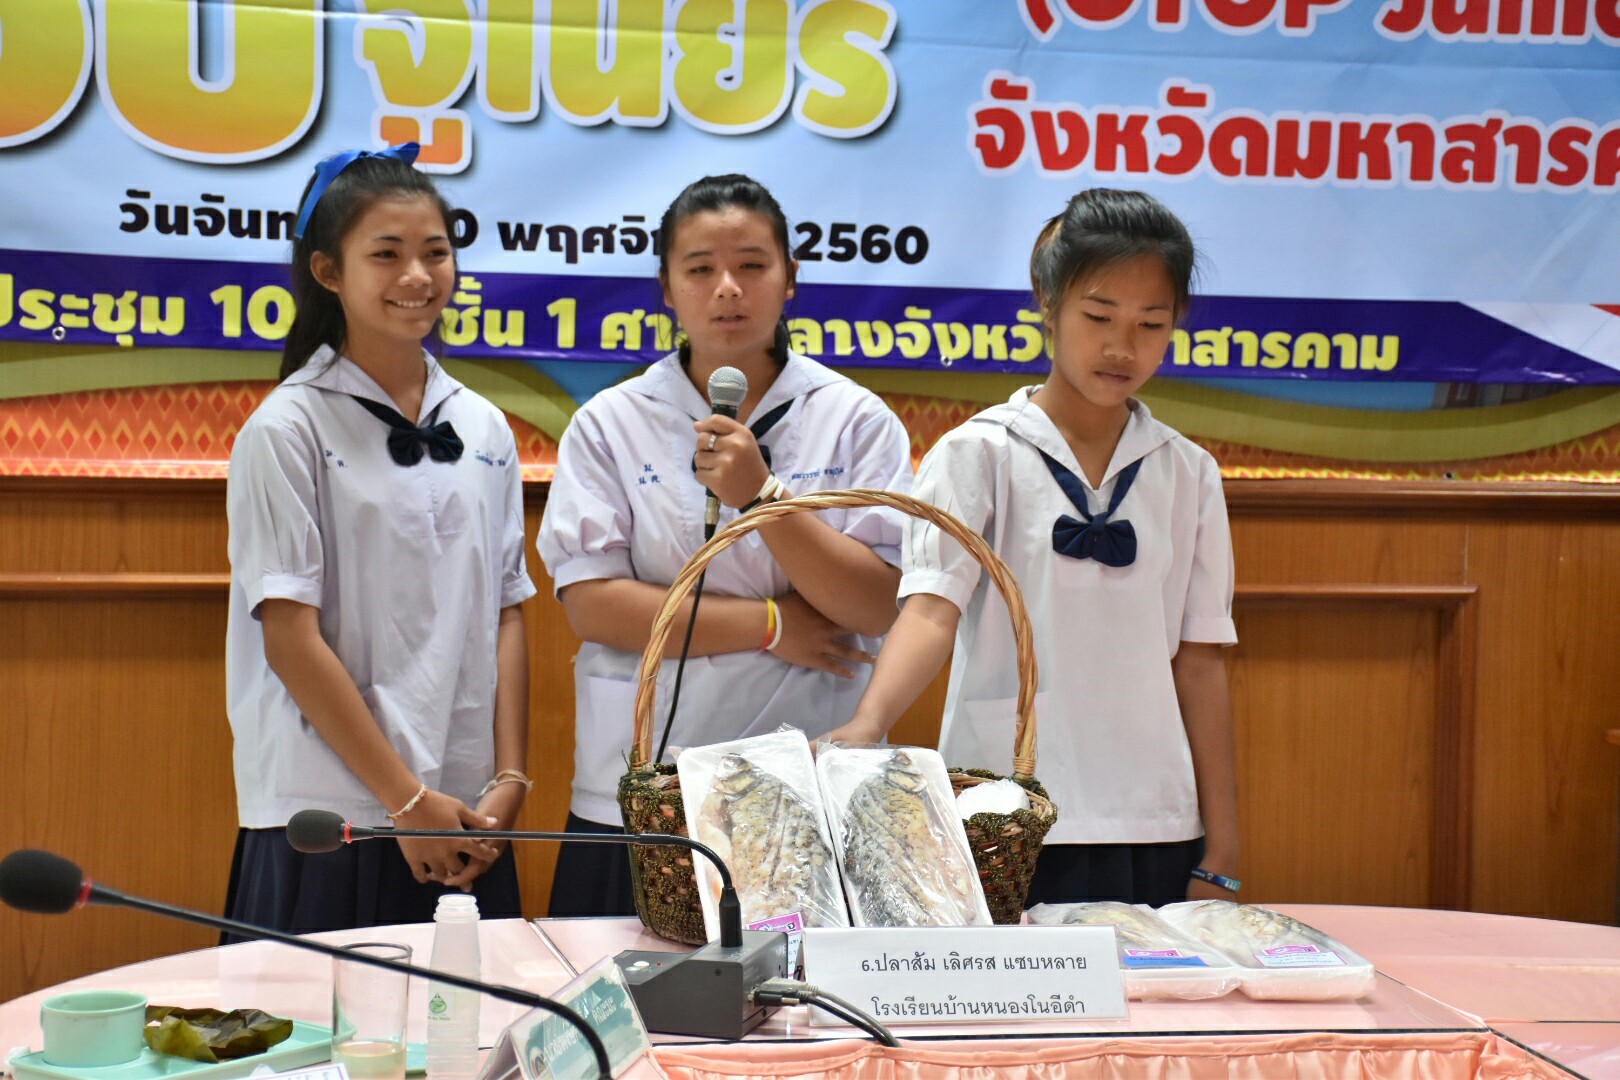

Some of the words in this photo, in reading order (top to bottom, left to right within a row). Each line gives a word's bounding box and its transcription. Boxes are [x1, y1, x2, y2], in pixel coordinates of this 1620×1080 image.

[119, 189, 297, 240] วันจันท
[793, 221, 929, 265] 2560
[547, 297, 577, 349] 1
[861, 951, 936, 972] 6.ปลาส้ม
[943, 951, 996, 970] เลิศรส
[1003, 955, 1088, 971] แซบหลาย
[870, 994, 1086, 1017] โรงเรียนบ้านหนองโนอีดำ
